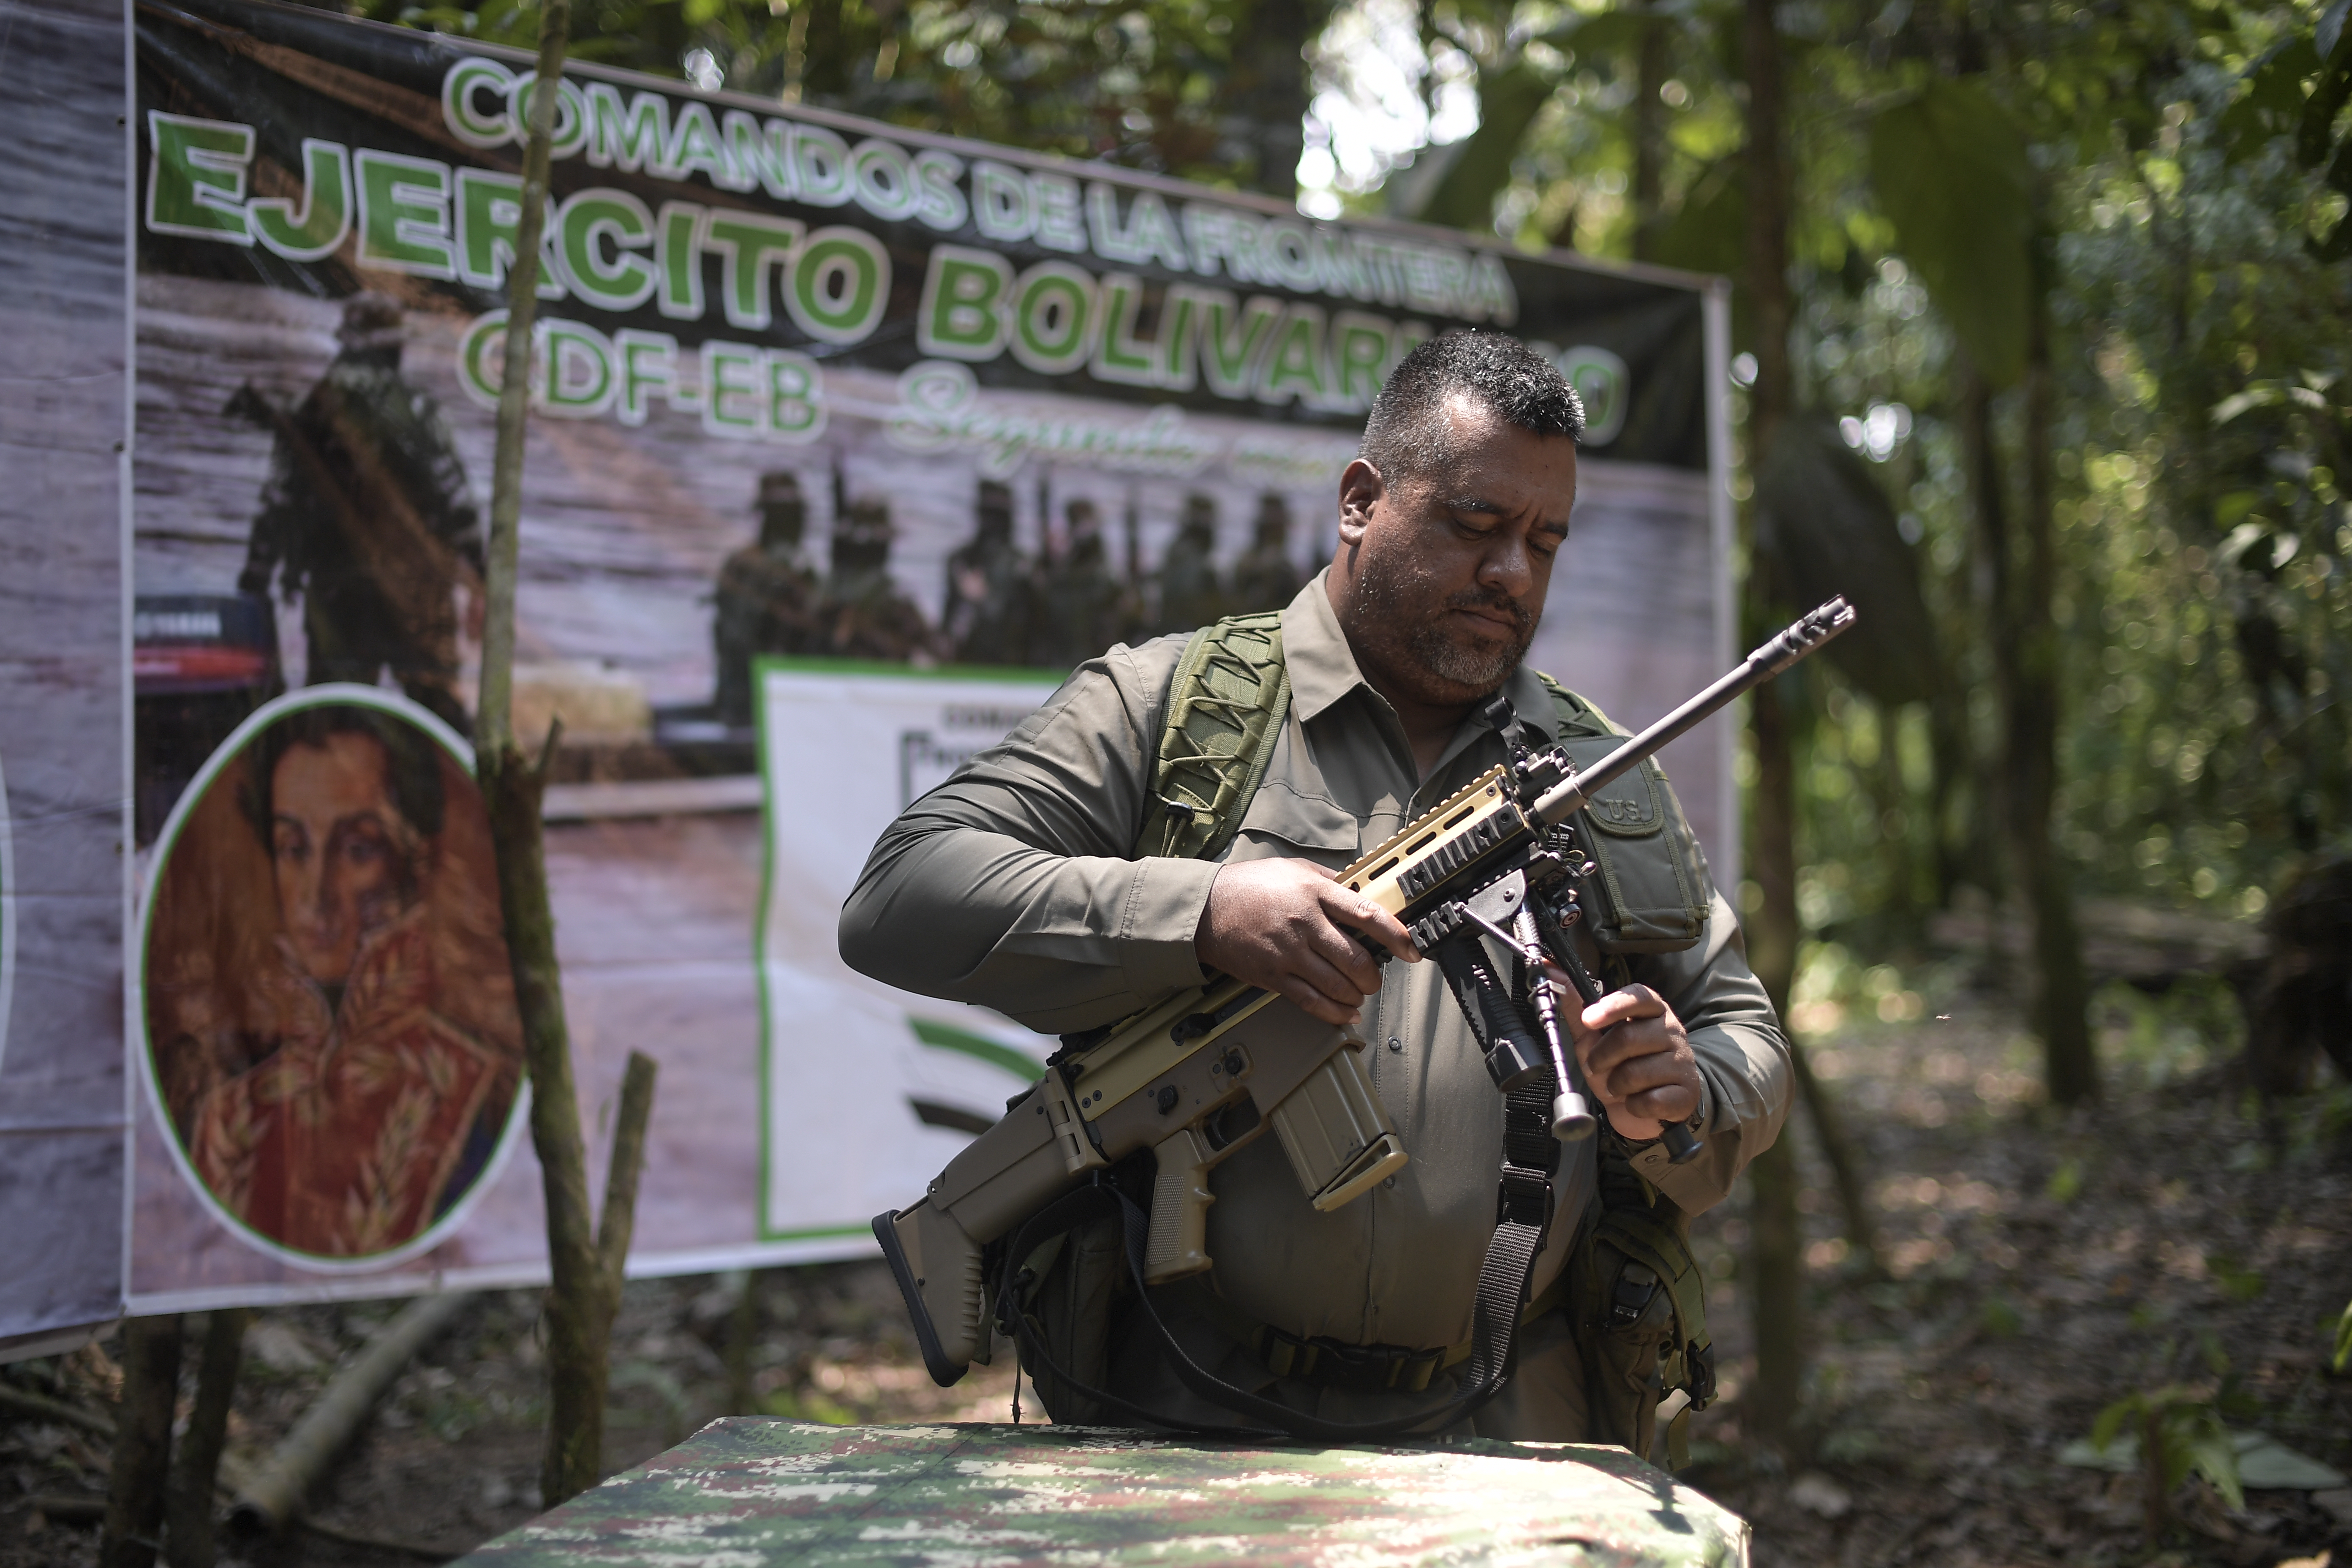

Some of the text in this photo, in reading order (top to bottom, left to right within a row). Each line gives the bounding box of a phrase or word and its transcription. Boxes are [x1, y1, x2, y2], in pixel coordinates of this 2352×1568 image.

[146, 109, 1631, 447] EJERCITO BOLIVARO
[441, 56, 1520, 327] COMANDOS DE LA FRONTERA
[1606, 798, 1642, 821] US
